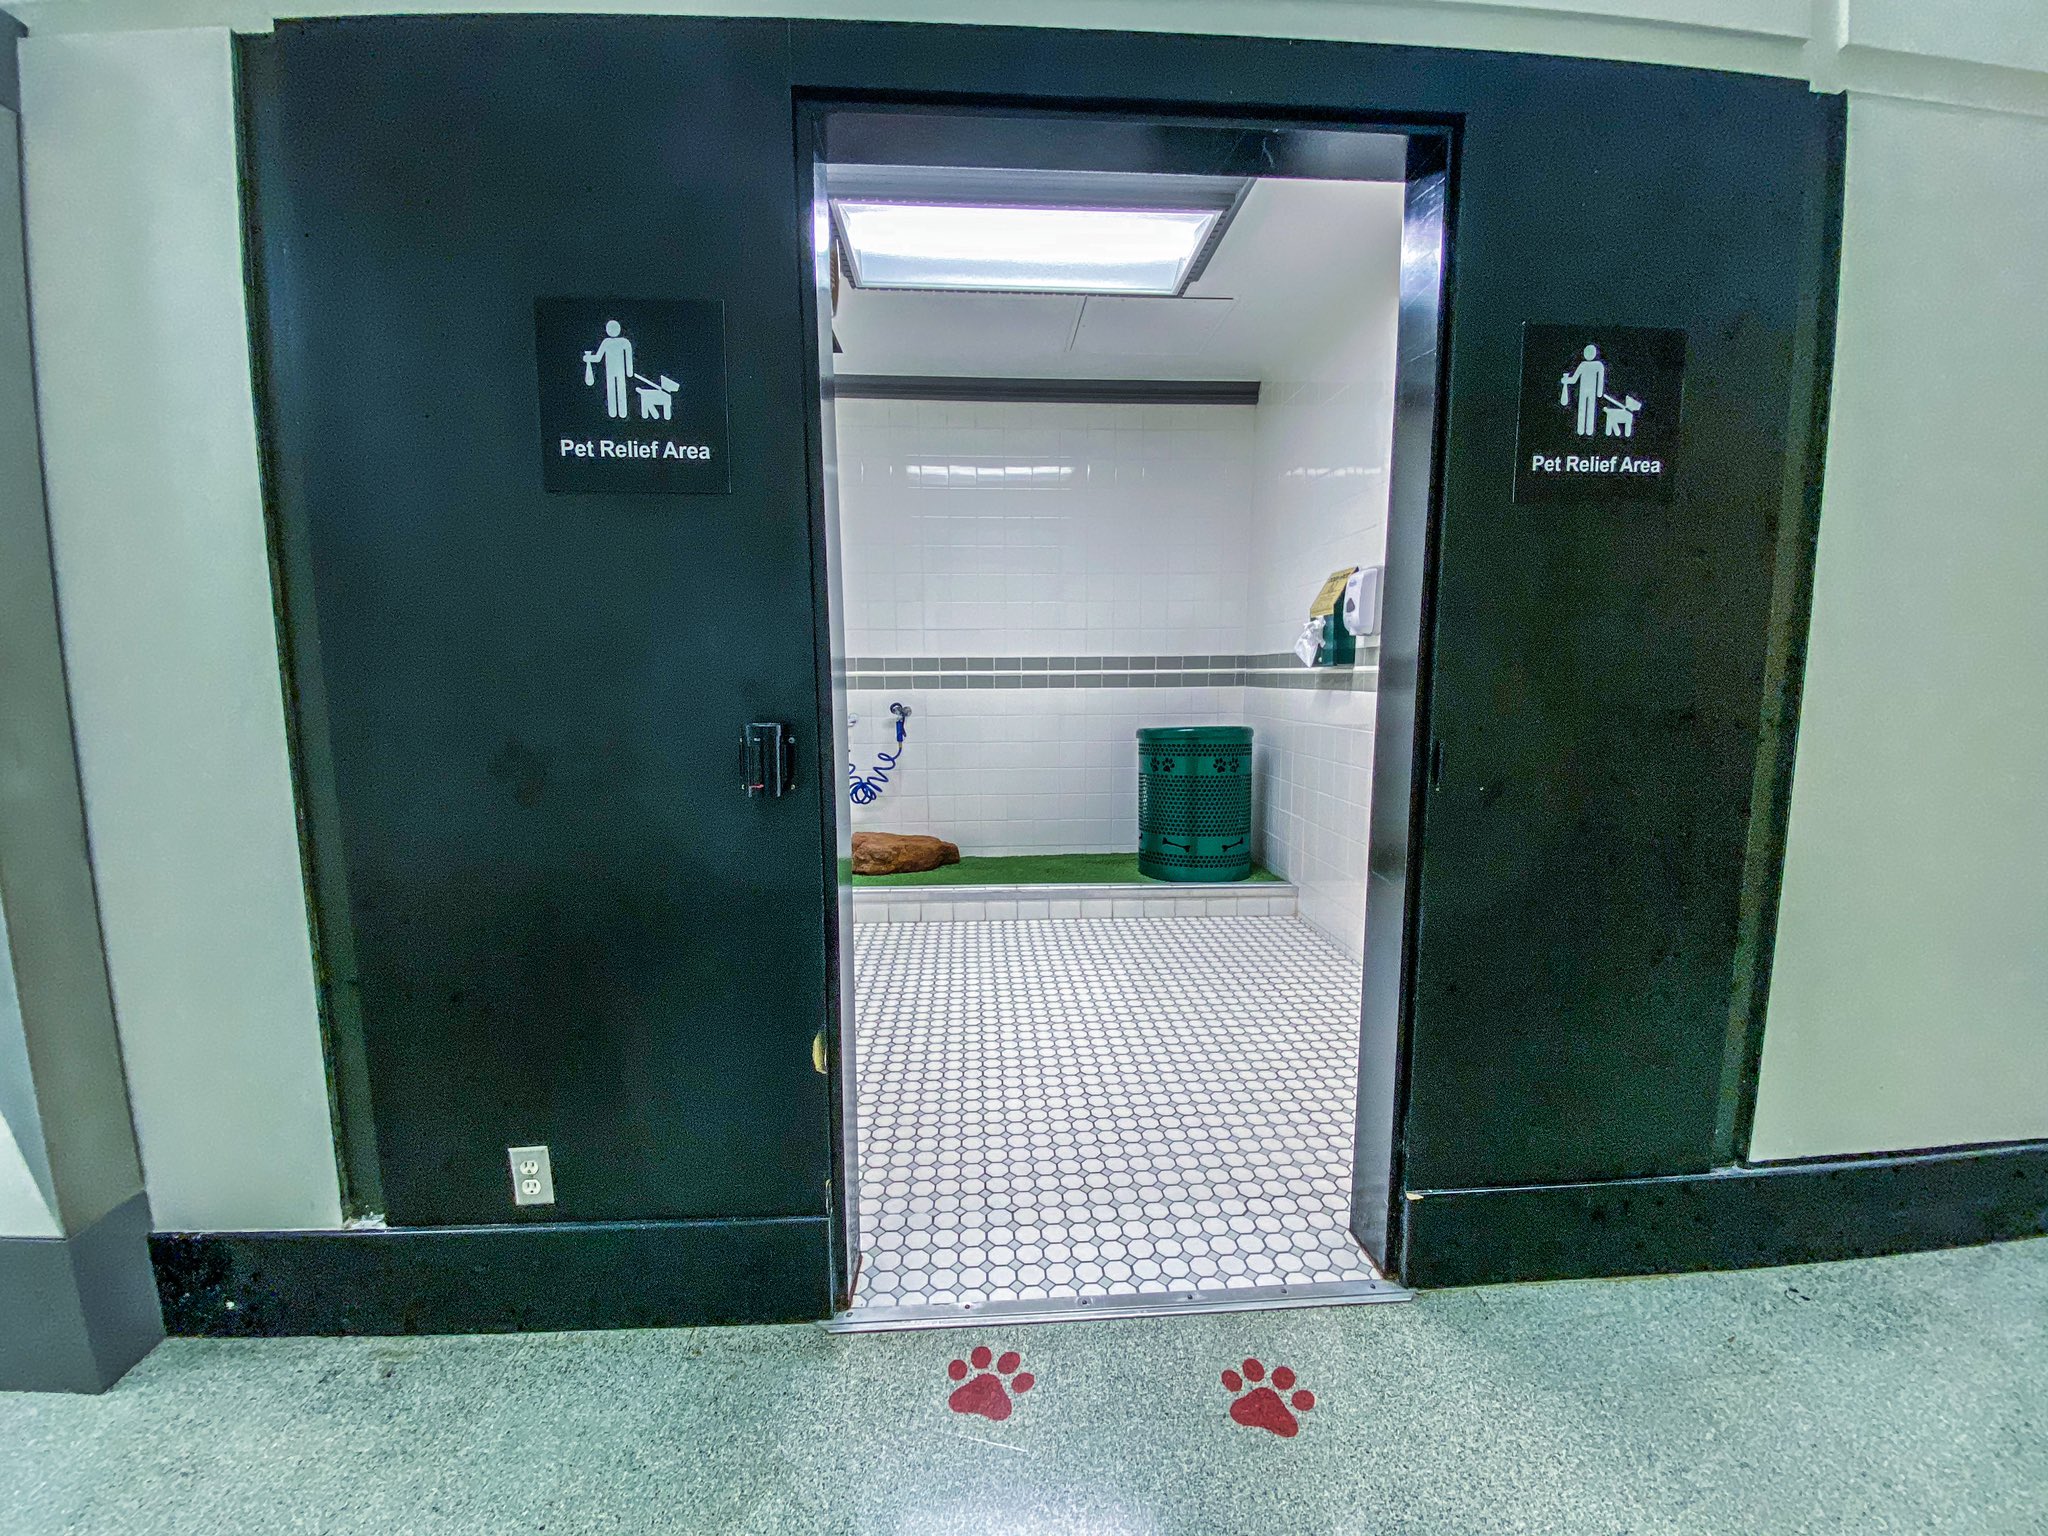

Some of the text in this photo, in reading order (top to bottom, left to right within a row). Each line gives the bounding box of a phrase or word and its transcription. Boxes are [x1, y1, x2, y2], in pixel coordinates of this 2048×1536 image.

[560, 439, 711, 460] Pet Relief Area
[1532, 455, 1661, 473] Pet Relief Area
